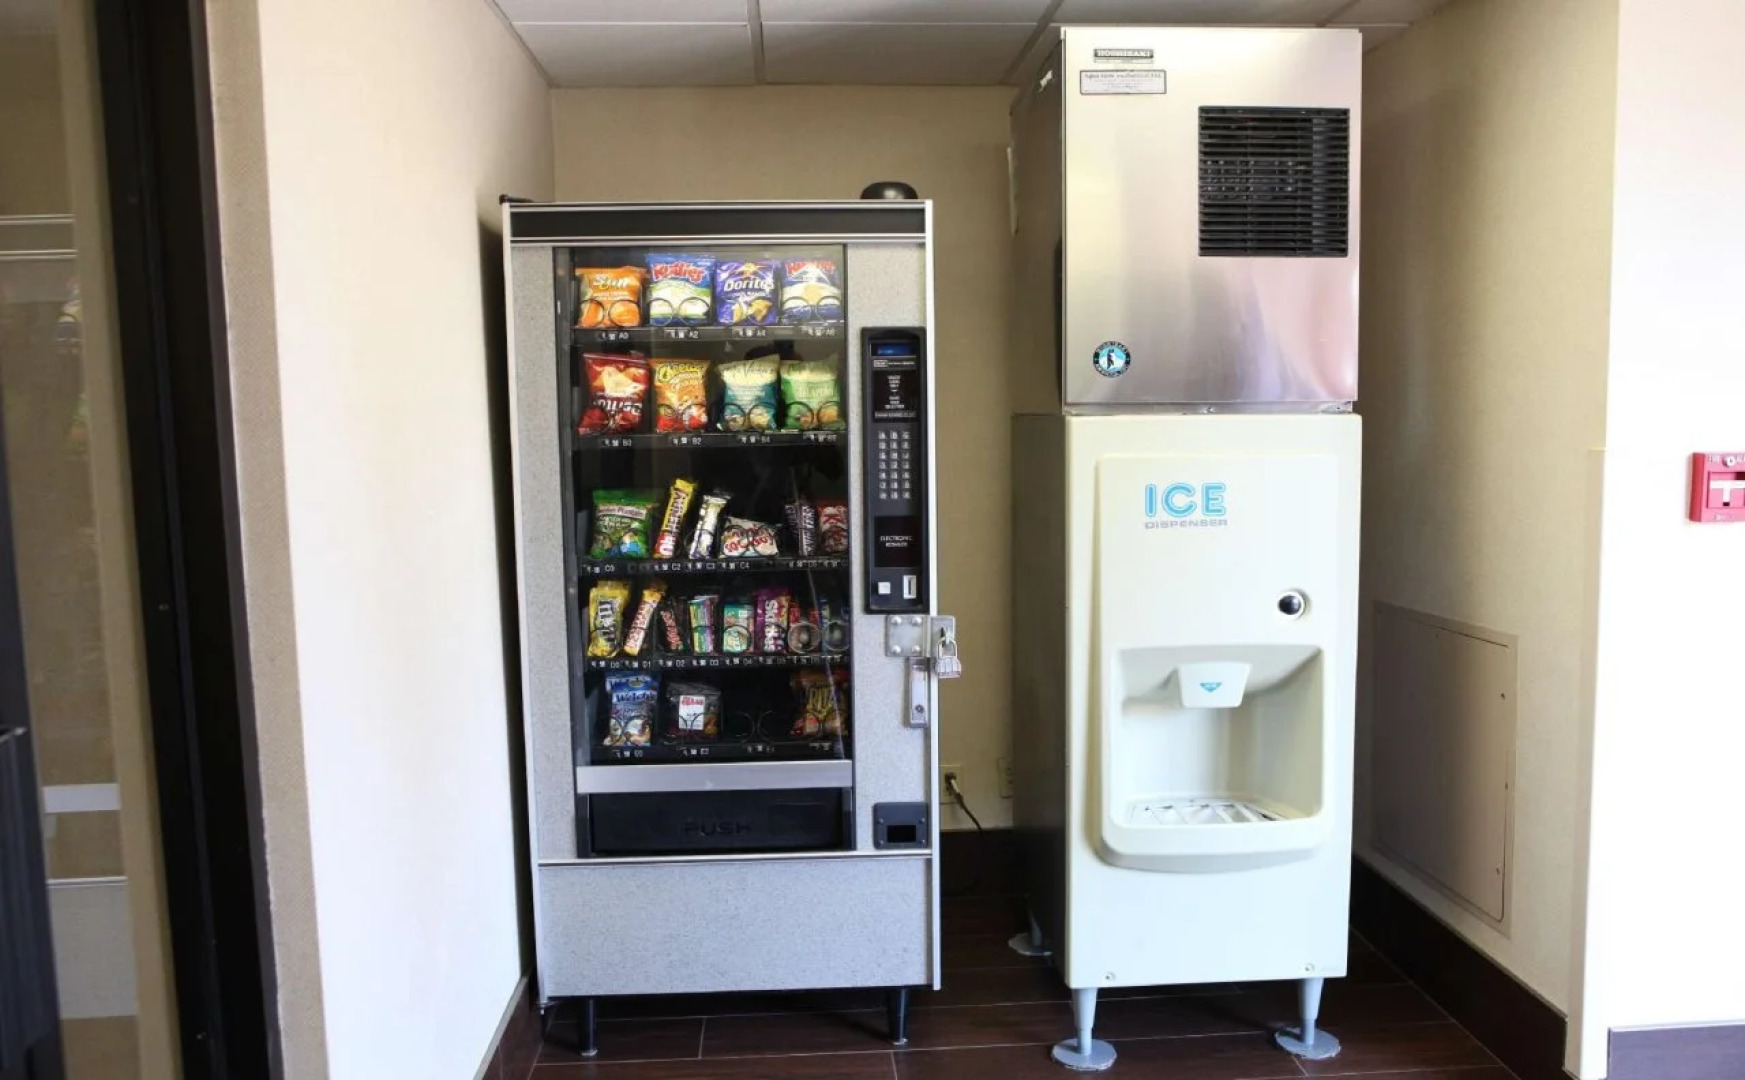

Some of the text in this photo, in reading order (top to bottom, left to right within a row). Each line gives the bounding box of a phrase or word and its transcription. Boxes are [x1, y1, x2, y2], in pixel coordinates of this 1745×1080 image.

[723, 278, 775, 292] Doritos
[591, 399, 643, 416] Dorito
[1145, 483, 1226, 518] ICE
[1144, 518, 1228, 530] DISPENSER
[684, 820, 752, 836] PUSH
